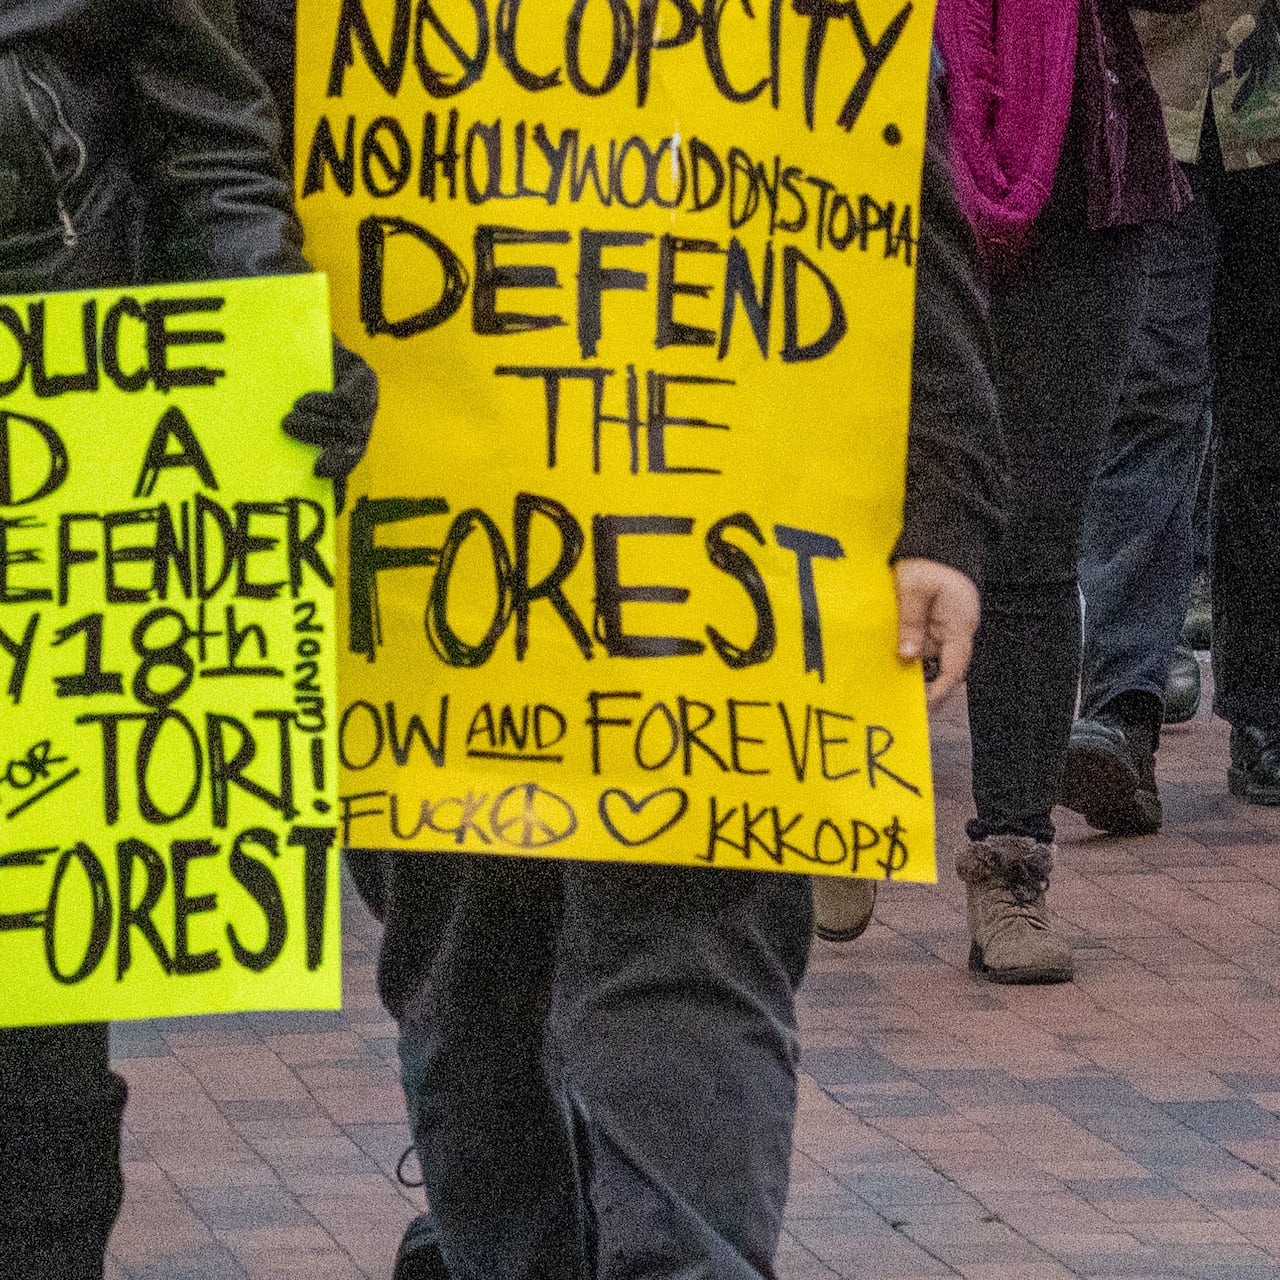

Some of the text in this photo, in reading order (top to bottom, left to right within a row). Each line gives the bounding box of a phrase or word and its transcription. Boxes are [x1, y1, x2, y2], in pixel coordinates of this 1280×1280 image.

[357, 215, 849, 364] DEFEND
[135, 406, 218, 497] A
[493, 365, 736, 475] THE
[347, 491, 845, 682] FOREST
[54, 601, 283, 706] 18th
[467, 702, 564, 749] AND
[585, 690, 921, 795] FOREVER
